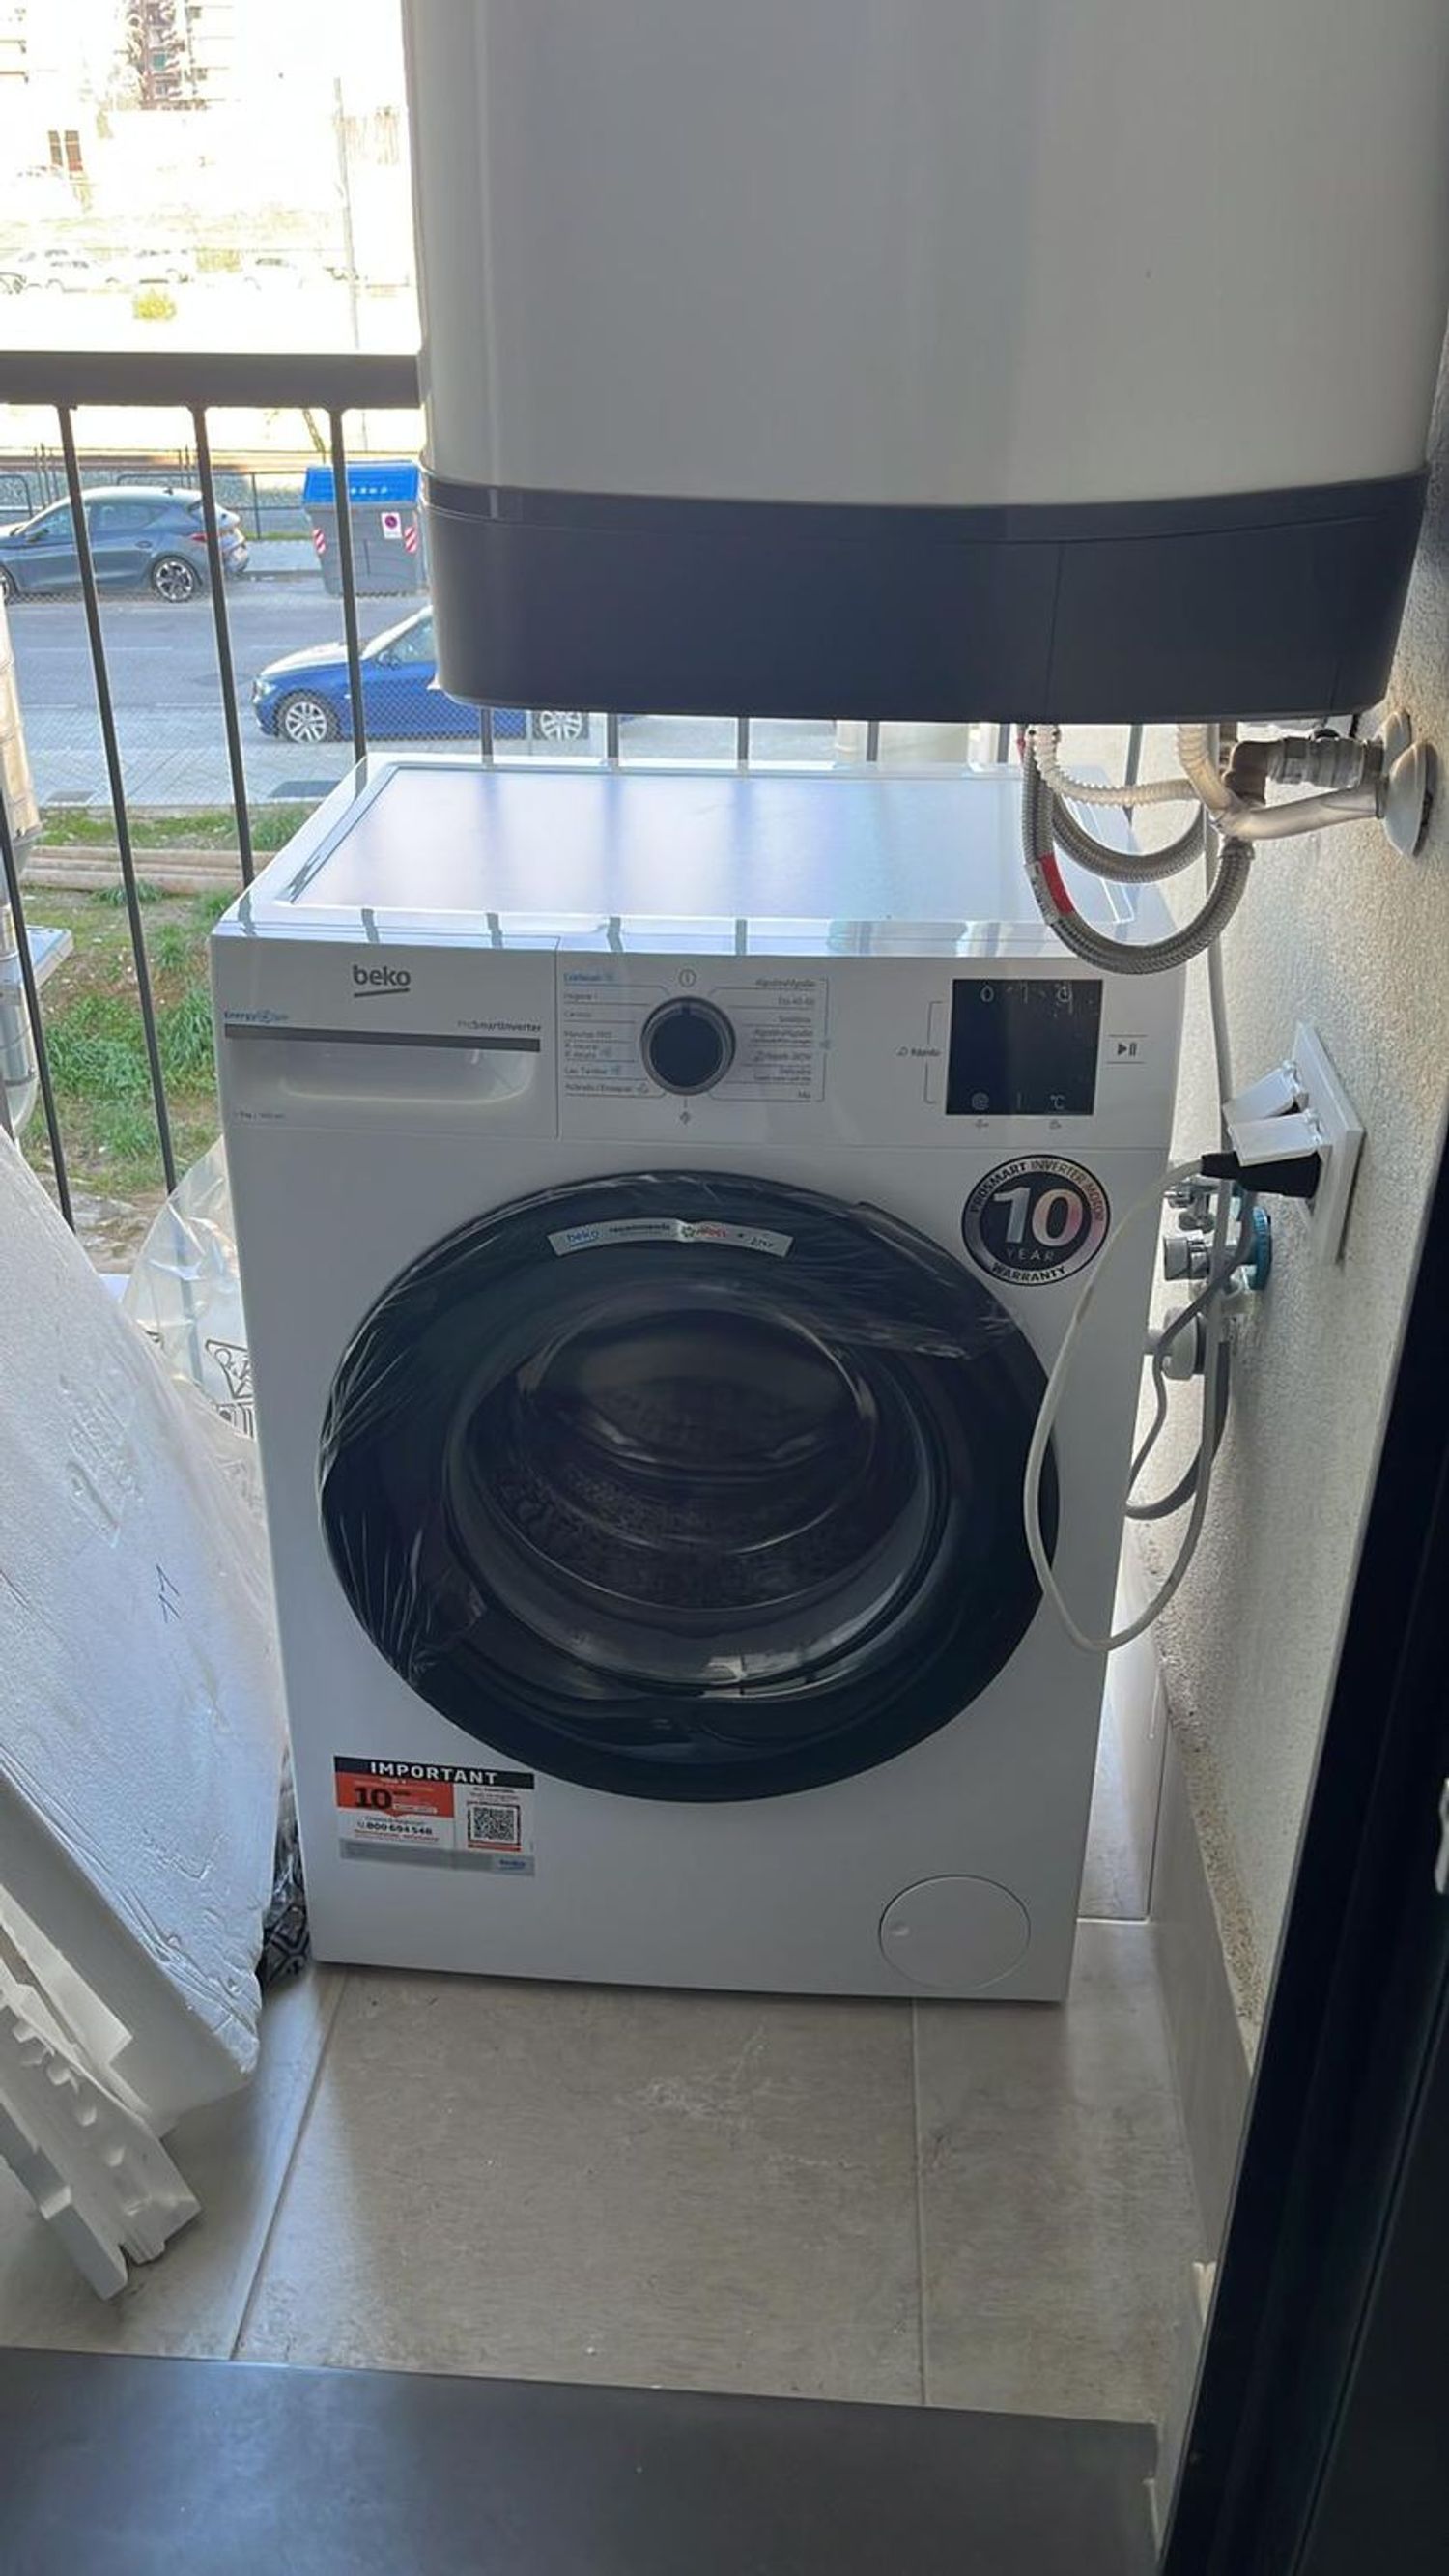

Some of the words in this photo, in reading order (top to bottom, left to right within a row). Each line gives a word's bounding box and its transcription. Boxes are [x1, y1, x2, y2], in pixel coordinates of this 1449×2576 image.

[353, 964, 411, 987] beko
[969, 1161, 1027, 1213] PROSMART
[1031, 1159, 1088, 1185] INVERTER
[993, 1186, 1084, 1247] 10
[1008, 1247, 1055, 1262] YEAR
[991, 1262, 1066, 1282] WARRANTY
[370, 1761, 498, 1785] IMPORTANT
[354, 1786, 393, 1810] 10
